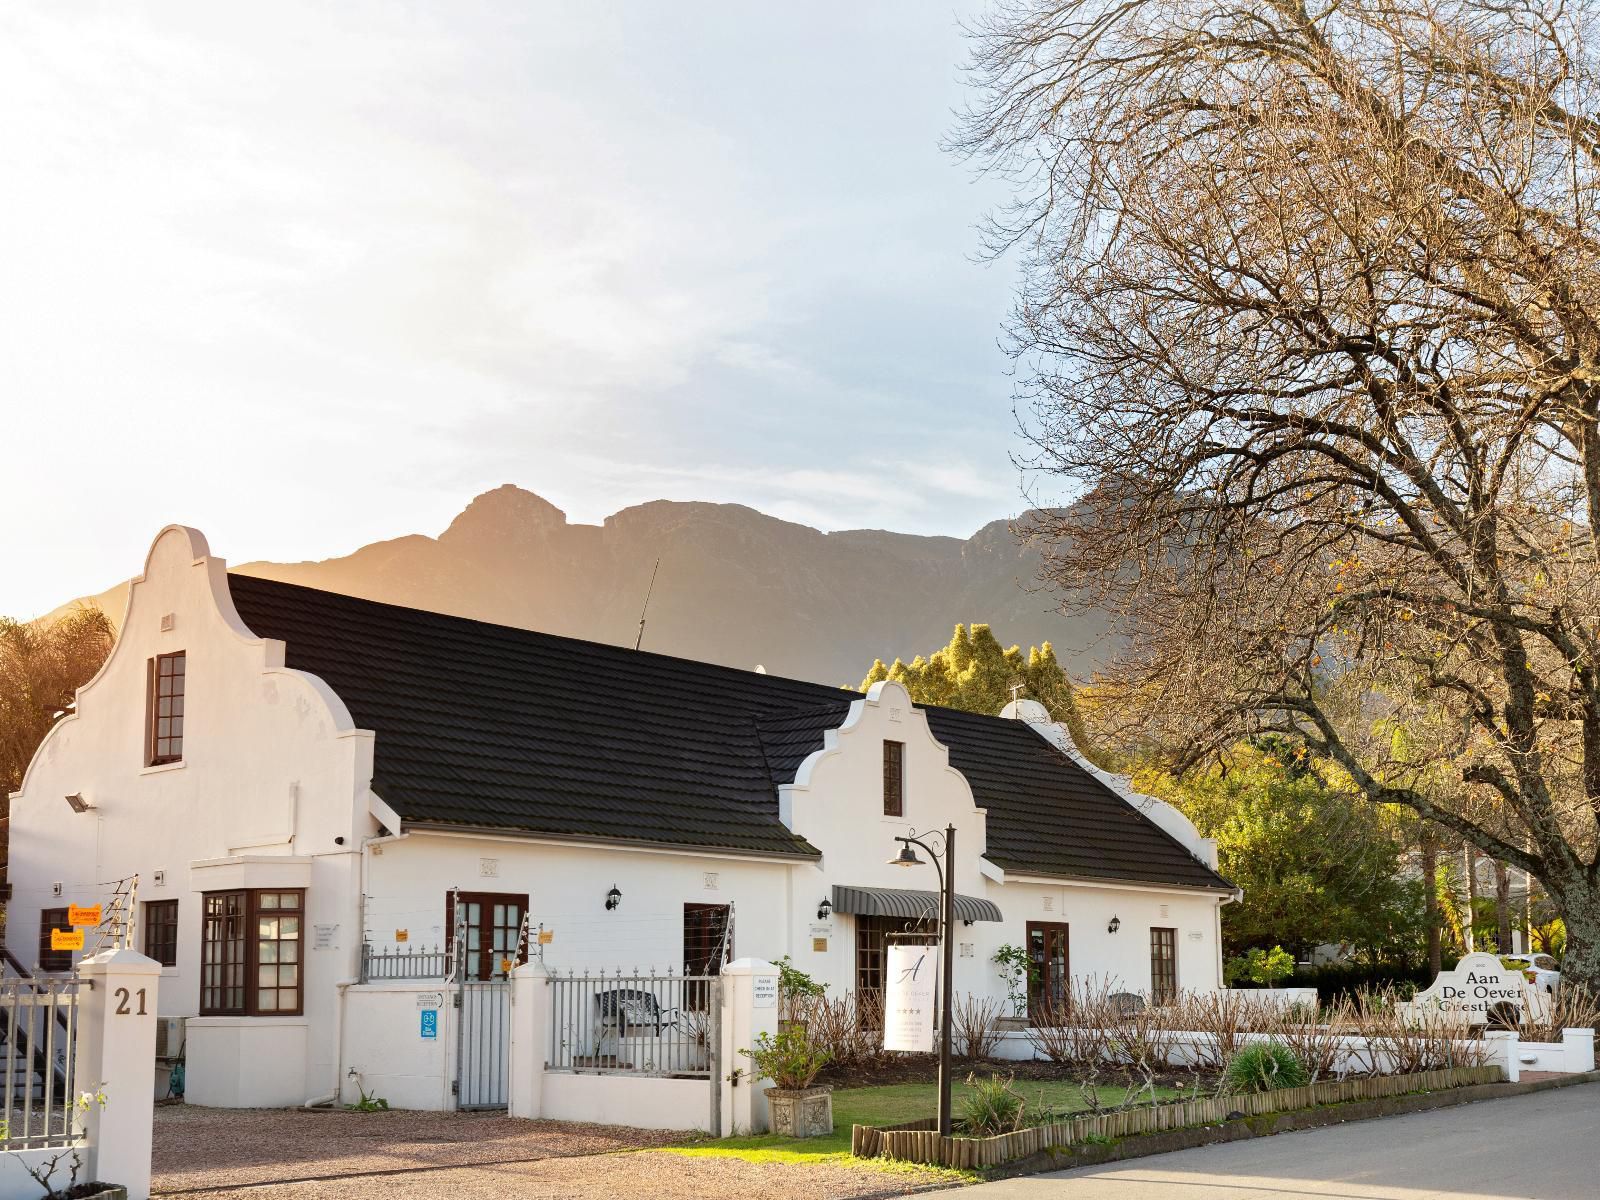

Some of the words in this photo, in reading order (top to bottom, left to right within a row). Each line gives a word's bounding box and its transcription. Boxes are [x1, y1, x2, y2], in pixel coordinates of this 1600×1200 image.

[896, 954, 925, 984] A
[1466, 972, 1499, 984] Aan
[114, 987, 148, 1015] 21
[1443, 986, 1466, 998] De
[1473, 986, 1523, 998] Oever
